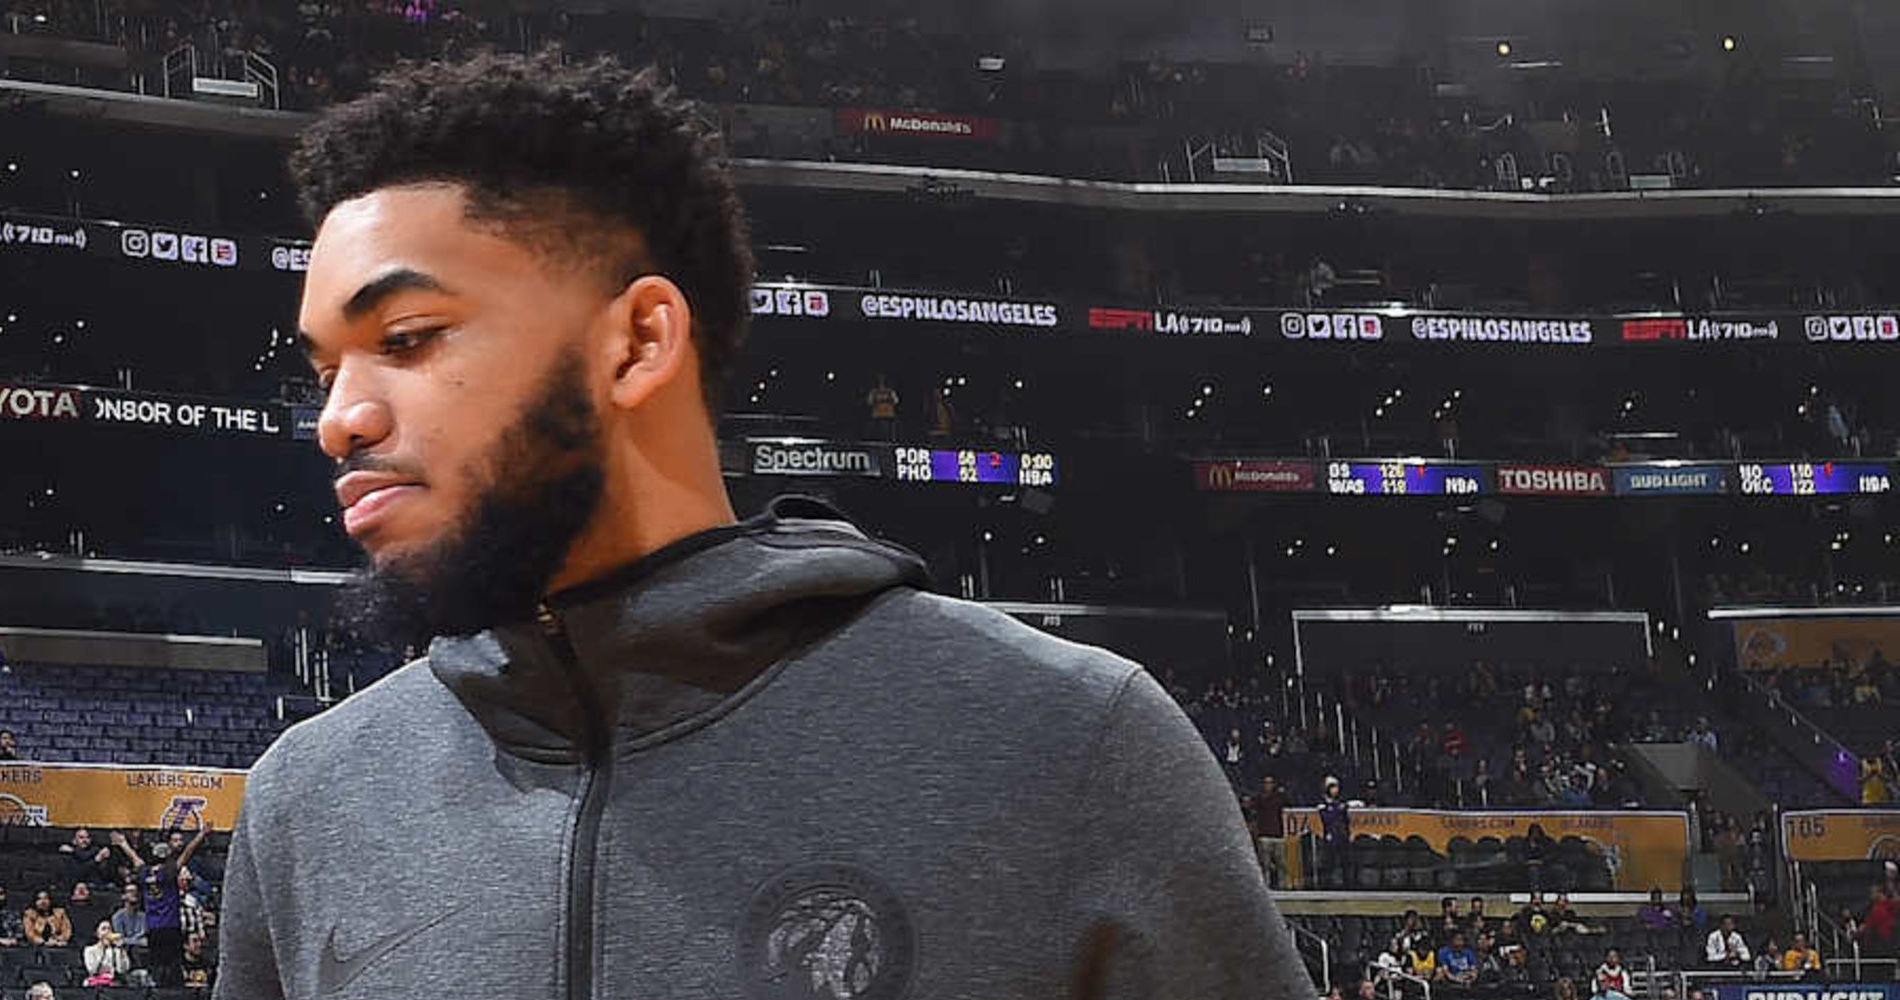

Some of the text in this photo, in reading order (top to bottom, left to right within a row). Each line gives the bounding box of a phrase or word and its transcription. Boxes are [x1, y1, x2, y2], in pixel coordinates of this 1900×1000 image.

[862, 294, 1058, 326] @ESPNLOSANGELES
[1089, 308, 1154, 330] ESPN
[1411, 317, 1593, 342] @ESPNLOSANGELES
[1622, 319, 1685, 341] ESPN
[176, 403, 206, 426] OF
[211, 406, 258, 430] THE
[755, 445, 871, 472] Spectrum
[895, 447, 931, 464] POR
[1500, 469, 1605, 490] TOSHIBA
[126, 773, 223, 790] LAKERS.COM
